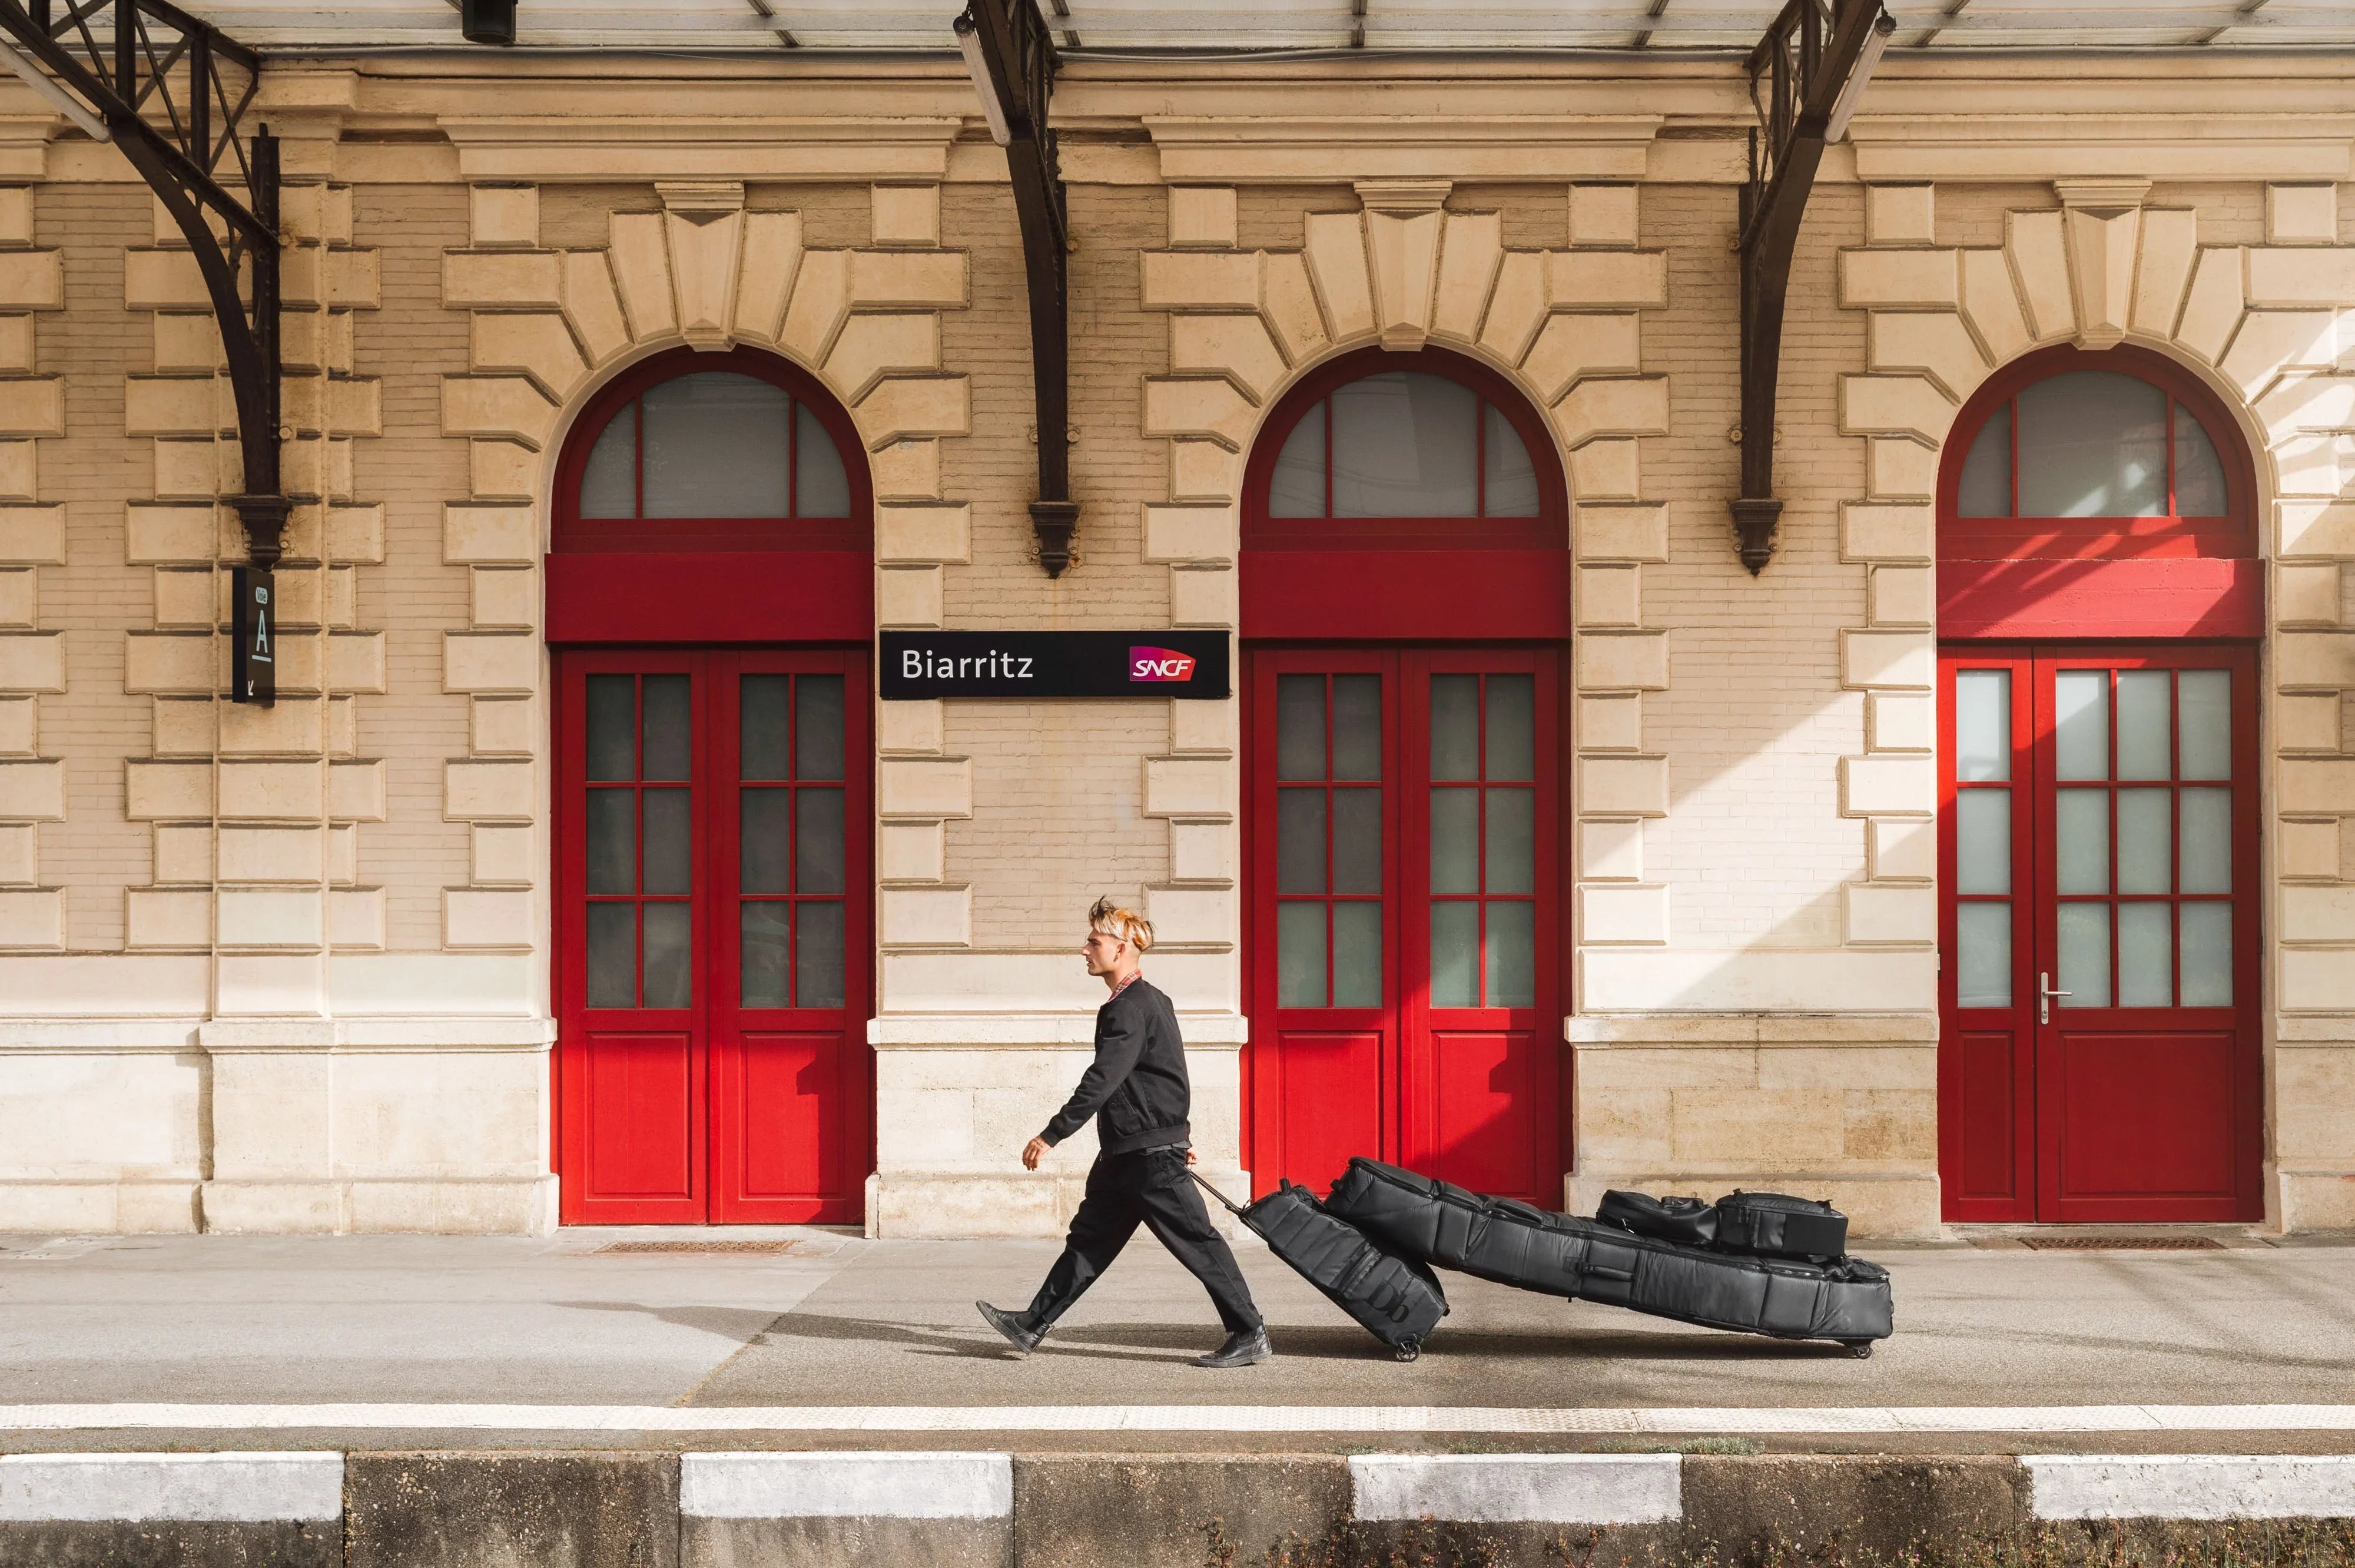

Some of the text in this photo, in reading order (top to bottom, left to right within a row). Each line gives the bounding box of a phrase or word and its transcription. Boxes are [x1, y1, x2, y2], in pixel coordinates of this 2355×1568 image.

[256, 609, 268, 654] A
[902, 649, 1033, 678] Biarritz
[1132, 659, 1192, 677] SNCF
[1362, 1279, 1409, 1324] Db
